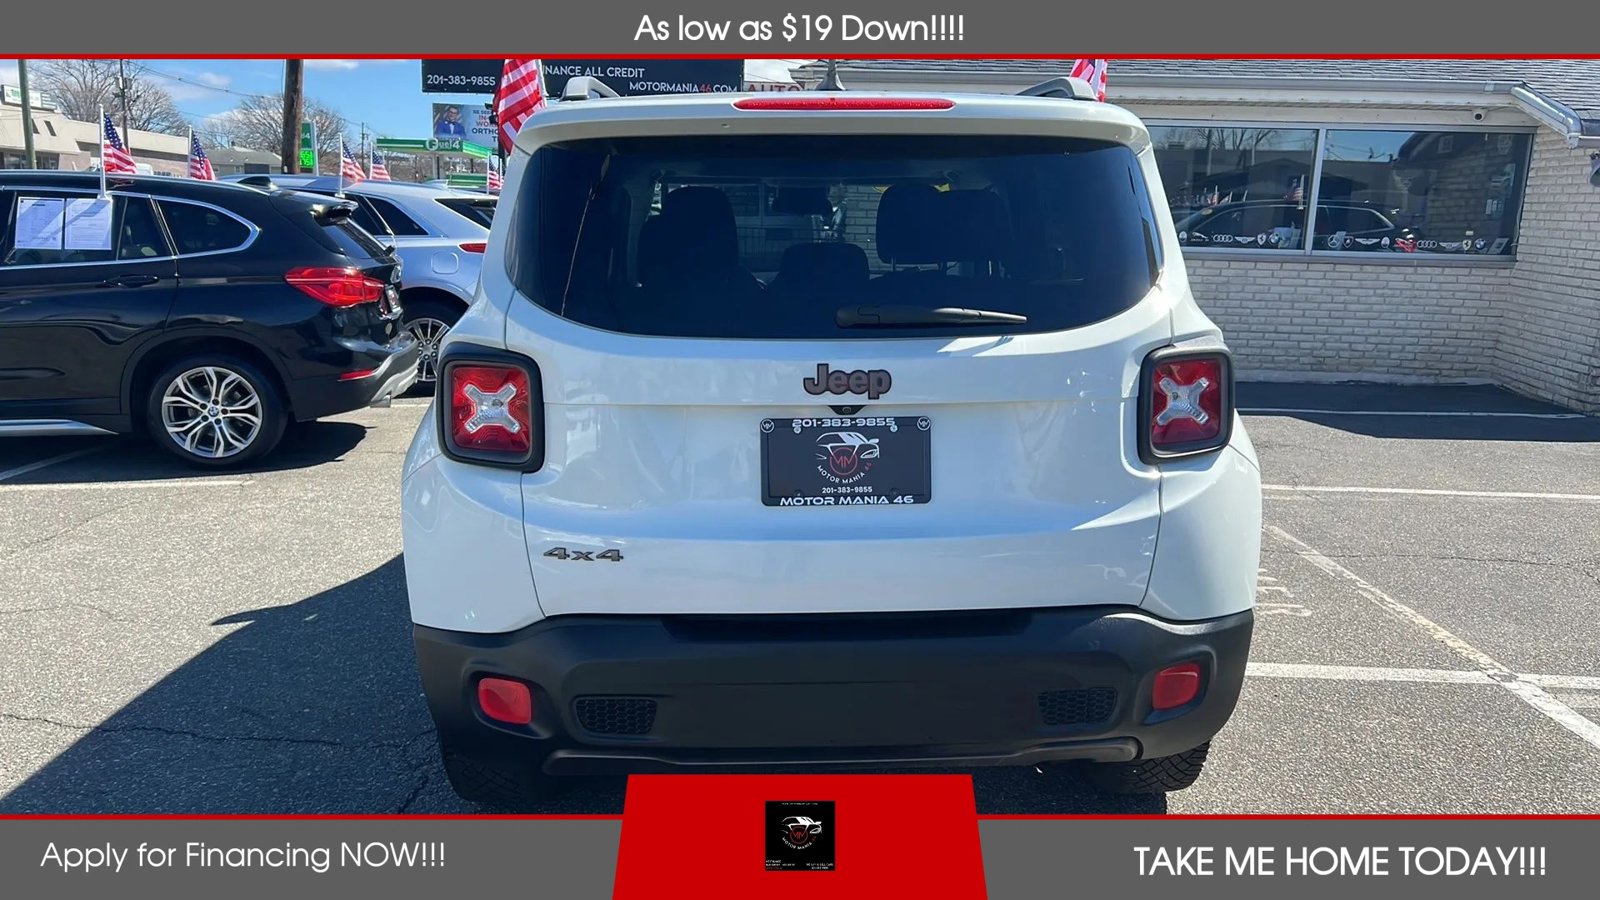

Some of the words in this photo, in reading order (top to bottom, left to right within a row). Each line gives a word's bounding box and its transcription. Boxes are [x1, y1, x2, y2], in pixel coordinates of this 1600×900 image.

[542, 64, 582, 76] INANCE
[584, 66, 604, 77] ALL
[606, 67, 645, 78] CREDIT
[427, 75, 496, 86] 201-383-9855
[629, 81, 738, 93] MOTORMANIA46.COM
[803, 363, 892, 400] Jeep
[792, 417, 895, 428] 201-383-9855
[817, 465, 840, 484] MOTOR
[842, 471, 866, 484] MANIA
[822, 486, 873, 494] 201-383-9855
[779, 496, 835, 506] MOTOR
[838, 496, 889, 505] MANIA
[893, 495, 914, 504] 46
[543, 547, 624, 562] 4x4
